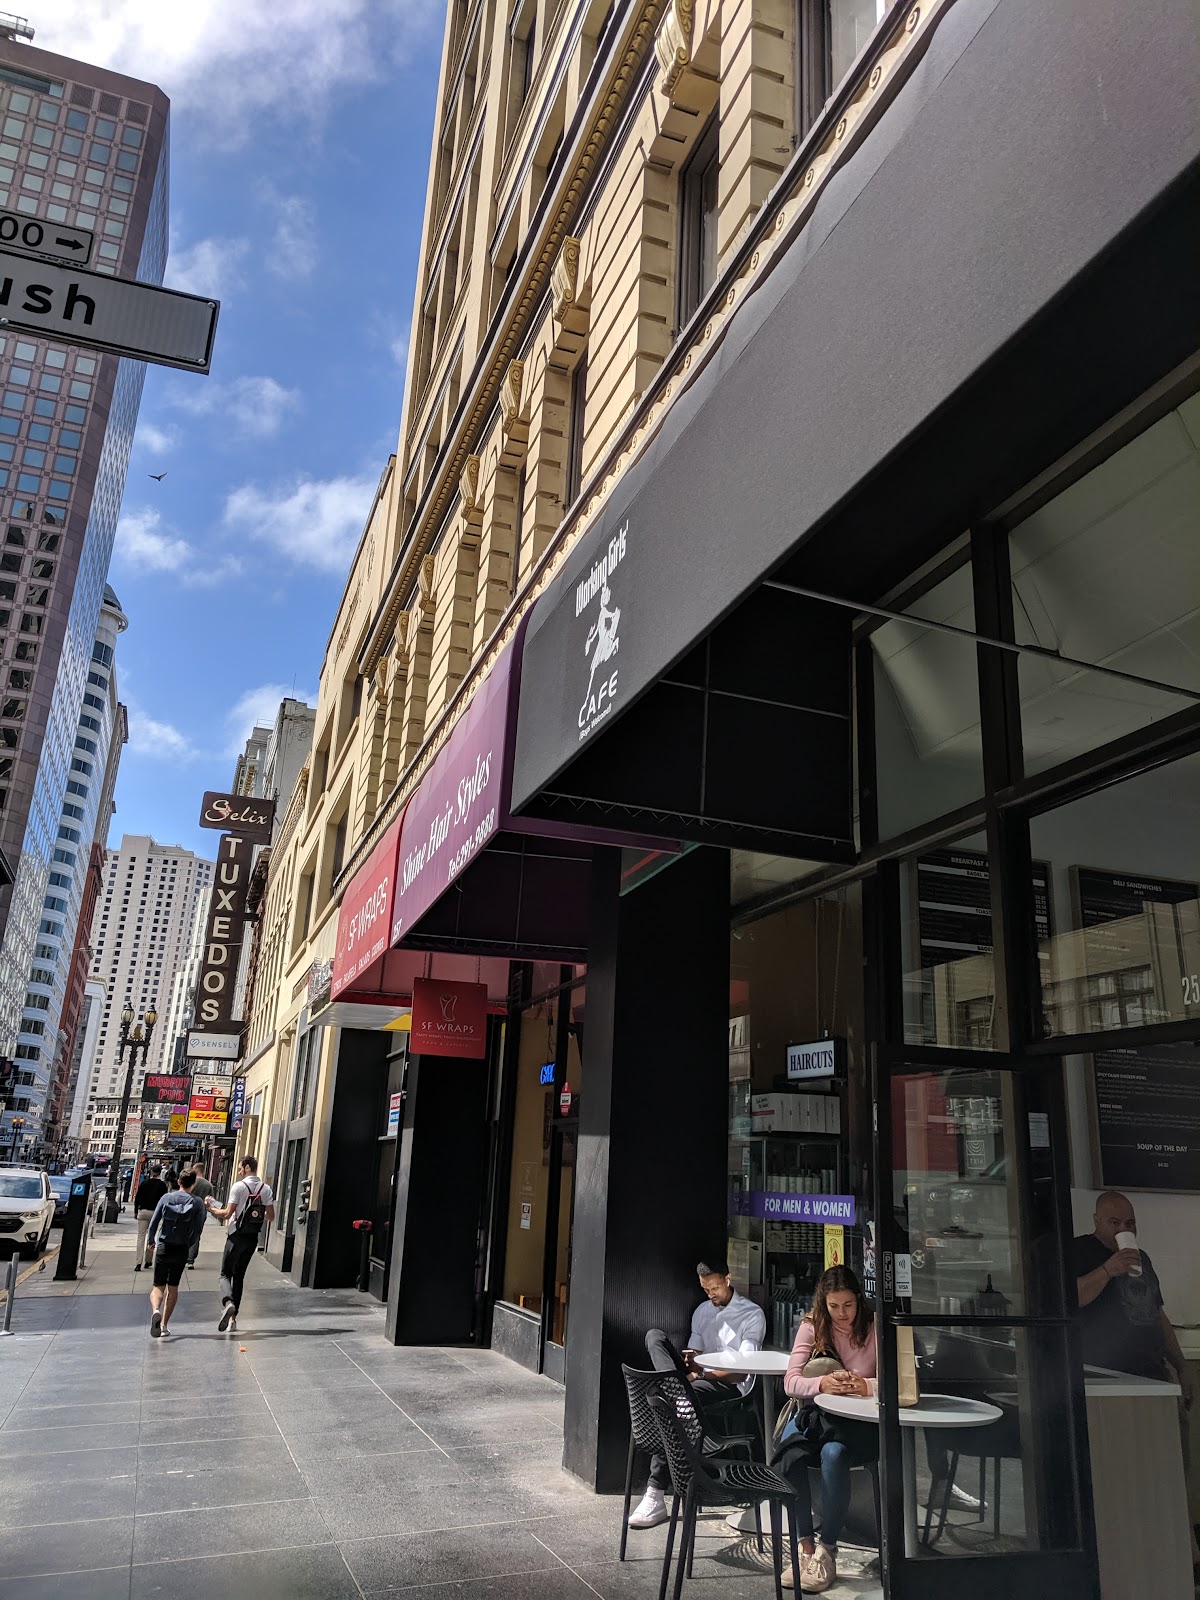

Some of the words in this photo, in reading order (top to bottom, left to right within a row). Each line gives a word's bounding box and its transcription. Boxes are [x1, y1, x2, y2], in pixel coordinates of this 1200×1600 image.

[575, 555, 607, 618] Working
[578, 670, 619, 728] CAFE
[204, 799, 268, 826] Selix
[400, 842, 426, 899] Shine
[426, 800, 453, 866] Hair
[453, 750, 493, 828] Styles
[950, 857, 984, 867] BREAKFAST
[1112, 879, 1125, 887] DELI
[1126, 880, 1162, 892] SANDWICHES
[357, 876, 389, 941] WRAPS
[200, 836, 243, 1022] TUXEDOS
[421, 1021, 432, 1031] SF
[436, 1022, 474, 1034] WRAPS
[201, 1040, 239, 1049] SENSELY
[789, 1049, 834, 1072] HAIRCUTS
[159, 1089, 185, 1100] PUB
[198, 1086, 223, 1096] FedEx
[194, 1112, 222, 1120] DHL
[1137, 1143, 1153, 1151] SOUP
[1163, 1144, 1175, 1152] THE
[764, 1198, 781, 1213] FOR
[782, 1199, 801, 1214] MEN
[803, 1200, 811, 1215] &
[813, 1201, 851, 1218] WOMEN
[884, 1255, 892, 1290] PUSH
